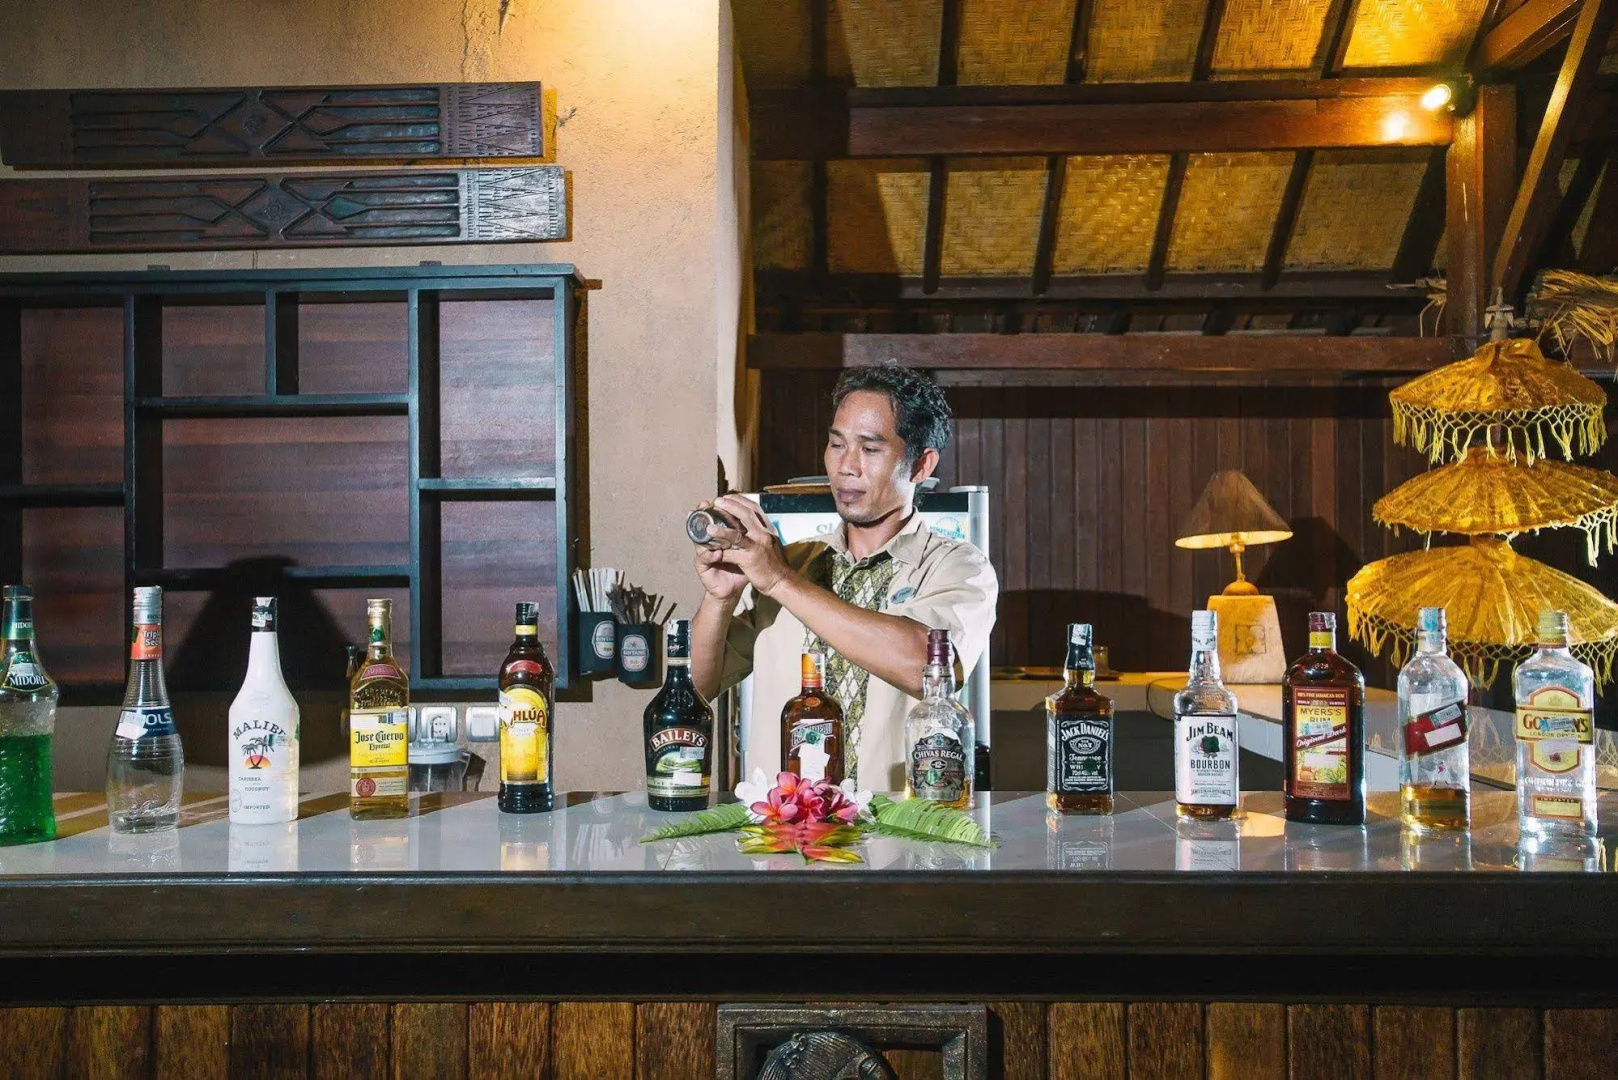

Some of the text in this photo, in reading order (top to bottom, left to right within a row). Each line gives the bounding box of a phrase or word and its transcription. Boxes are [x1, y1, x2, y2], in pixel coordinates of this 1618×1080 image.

[9, 675, 45, 686] MIDORI
[145, 712, 172, 726] OLS
[1300, 708, 1342, 716] MYERS'S
[1522, 713, 1589, 733] GON'S
[354, 730, 404, 744] Jose Cuervo
[652, 730, 705, 748] BAILEYS
[1060, 723, 1109, 741] JACK DANIEL'S
[1186, 722, 1234, 742] JIM BEAM
[1296, 732, 1326, 748] Original
[1327, 726, 1347, 739] Dark
[914, 750, 963, 761] CHIVAS REGAL
[1190, 759, 1231, 770] BOURBON
